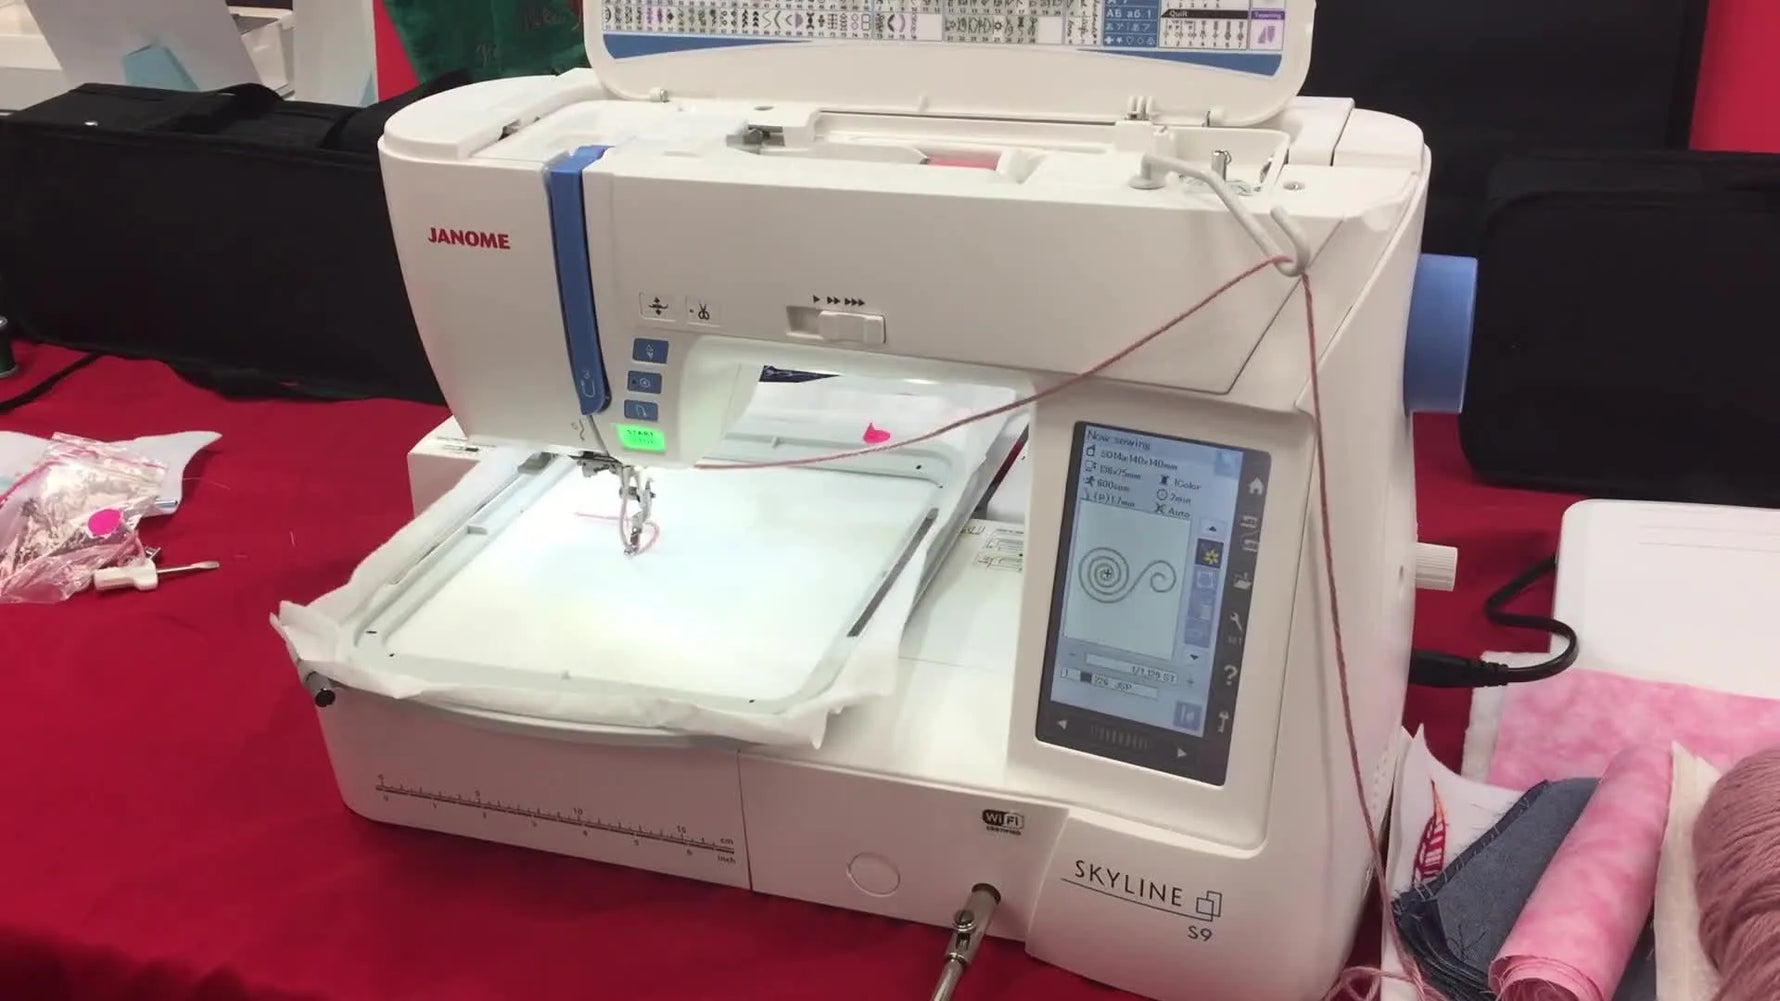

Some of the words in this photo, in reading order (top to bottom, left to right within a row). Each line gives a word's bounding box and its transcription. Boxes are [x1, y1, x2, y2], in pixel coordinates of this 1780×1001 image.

[428, 227, 510, 250] JANOME
[1087, 429, 1110, 443] Now
[1168, 506, 1190, 518] Auto
[676, 825, 686, 834] 15
[1075, 860, 1183, 907] SKYLINE
[1187, 925, 1212, 942] S9
